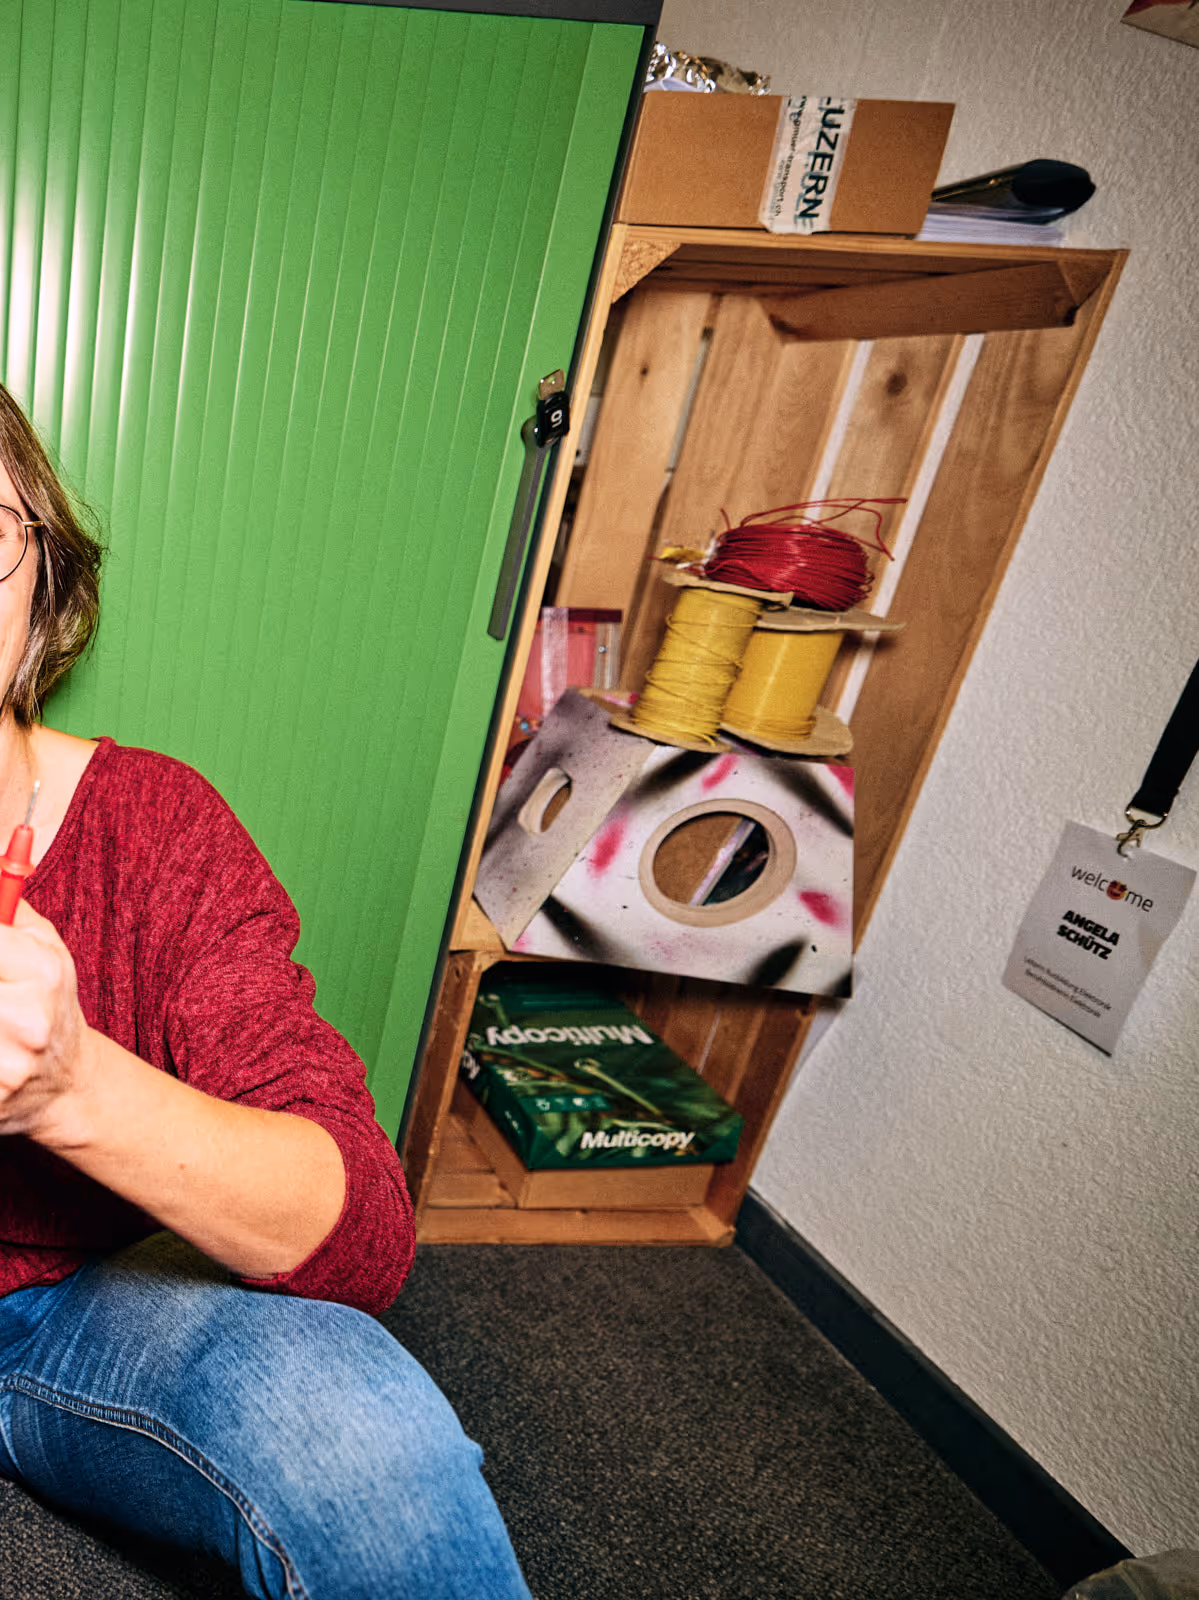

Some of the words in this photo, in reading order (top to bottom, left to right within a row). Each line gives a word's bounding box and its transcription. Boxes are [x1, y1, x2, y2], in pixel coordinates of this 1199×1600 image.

[1062, 910, 1120, 946] ANGELA
[1057, 925, 1113, 960] SCHÜTZ
[486, 1024, 654, 1046] Multicopy
[580, 1131, 696, 1149] Multicopy
